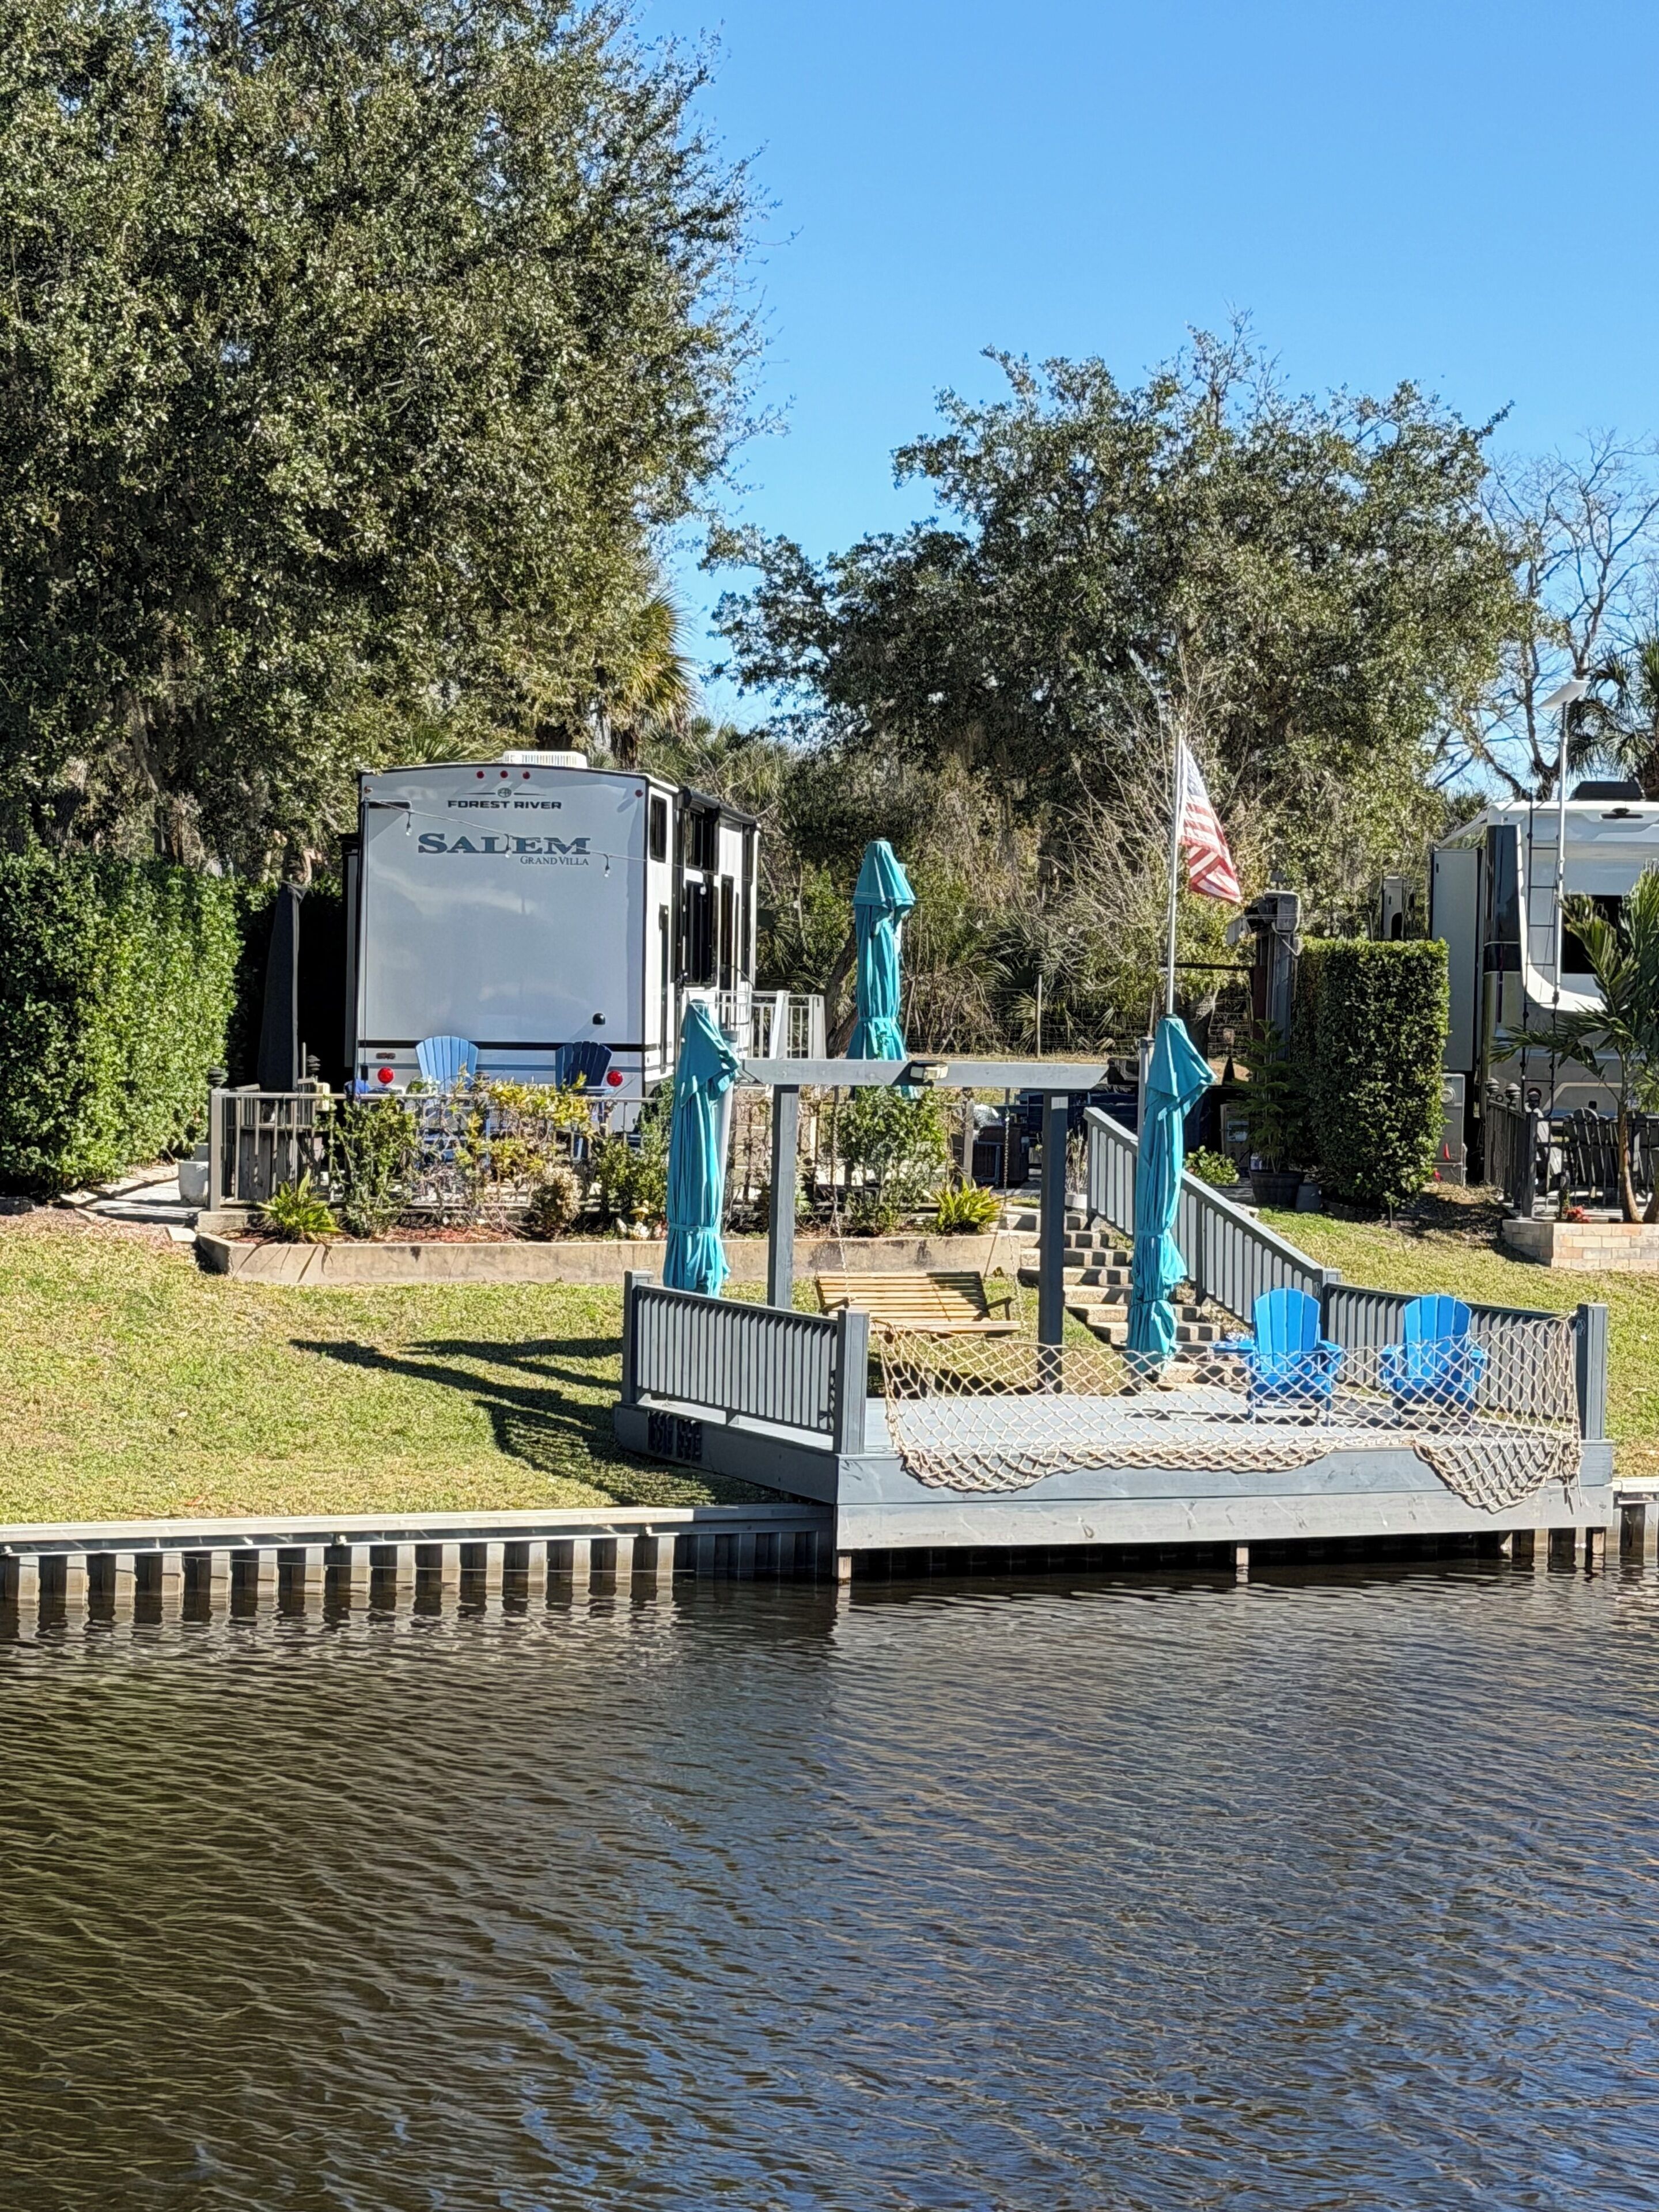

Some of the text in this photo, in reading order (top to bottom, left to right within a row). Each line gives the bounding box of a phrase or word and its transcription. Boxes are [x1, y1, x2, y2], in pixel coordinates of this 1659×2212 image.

[448, 801, 562, 809] FOREST RIVER
[418, 833, 590, 855] SALEM
[520, 856, 589, 865] GRAND VILLA
